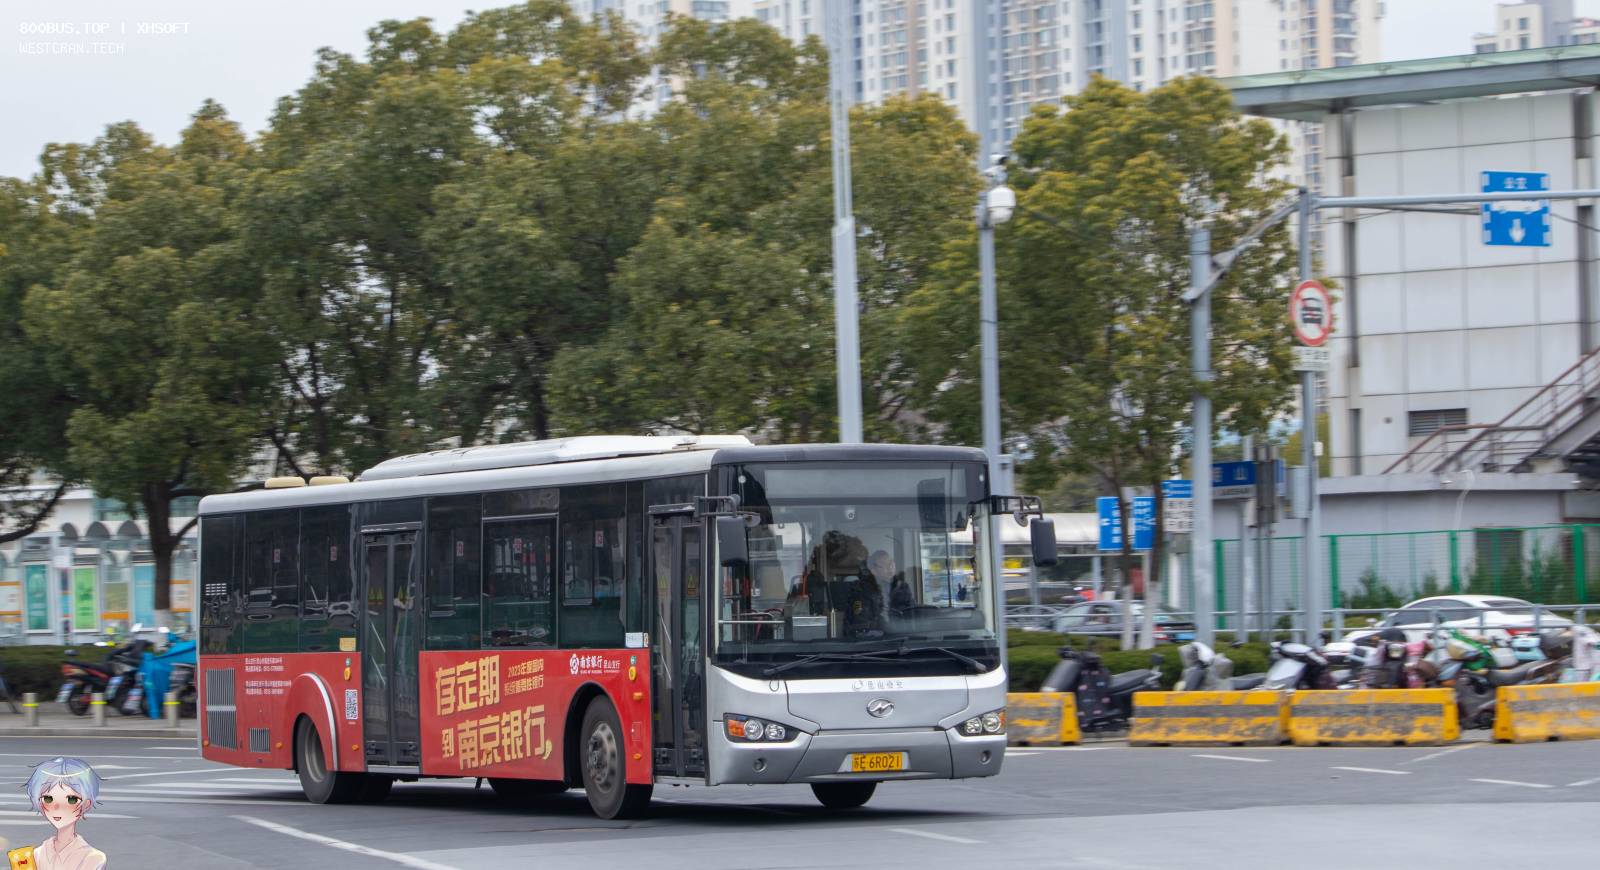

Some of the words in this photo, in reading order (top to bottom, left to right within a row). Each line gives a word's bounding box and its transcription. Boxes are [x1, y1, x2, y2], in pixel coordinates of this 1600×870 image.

[580, 655, 603, 668] 南京银行
[435, 654, 500, 716] 存定期
